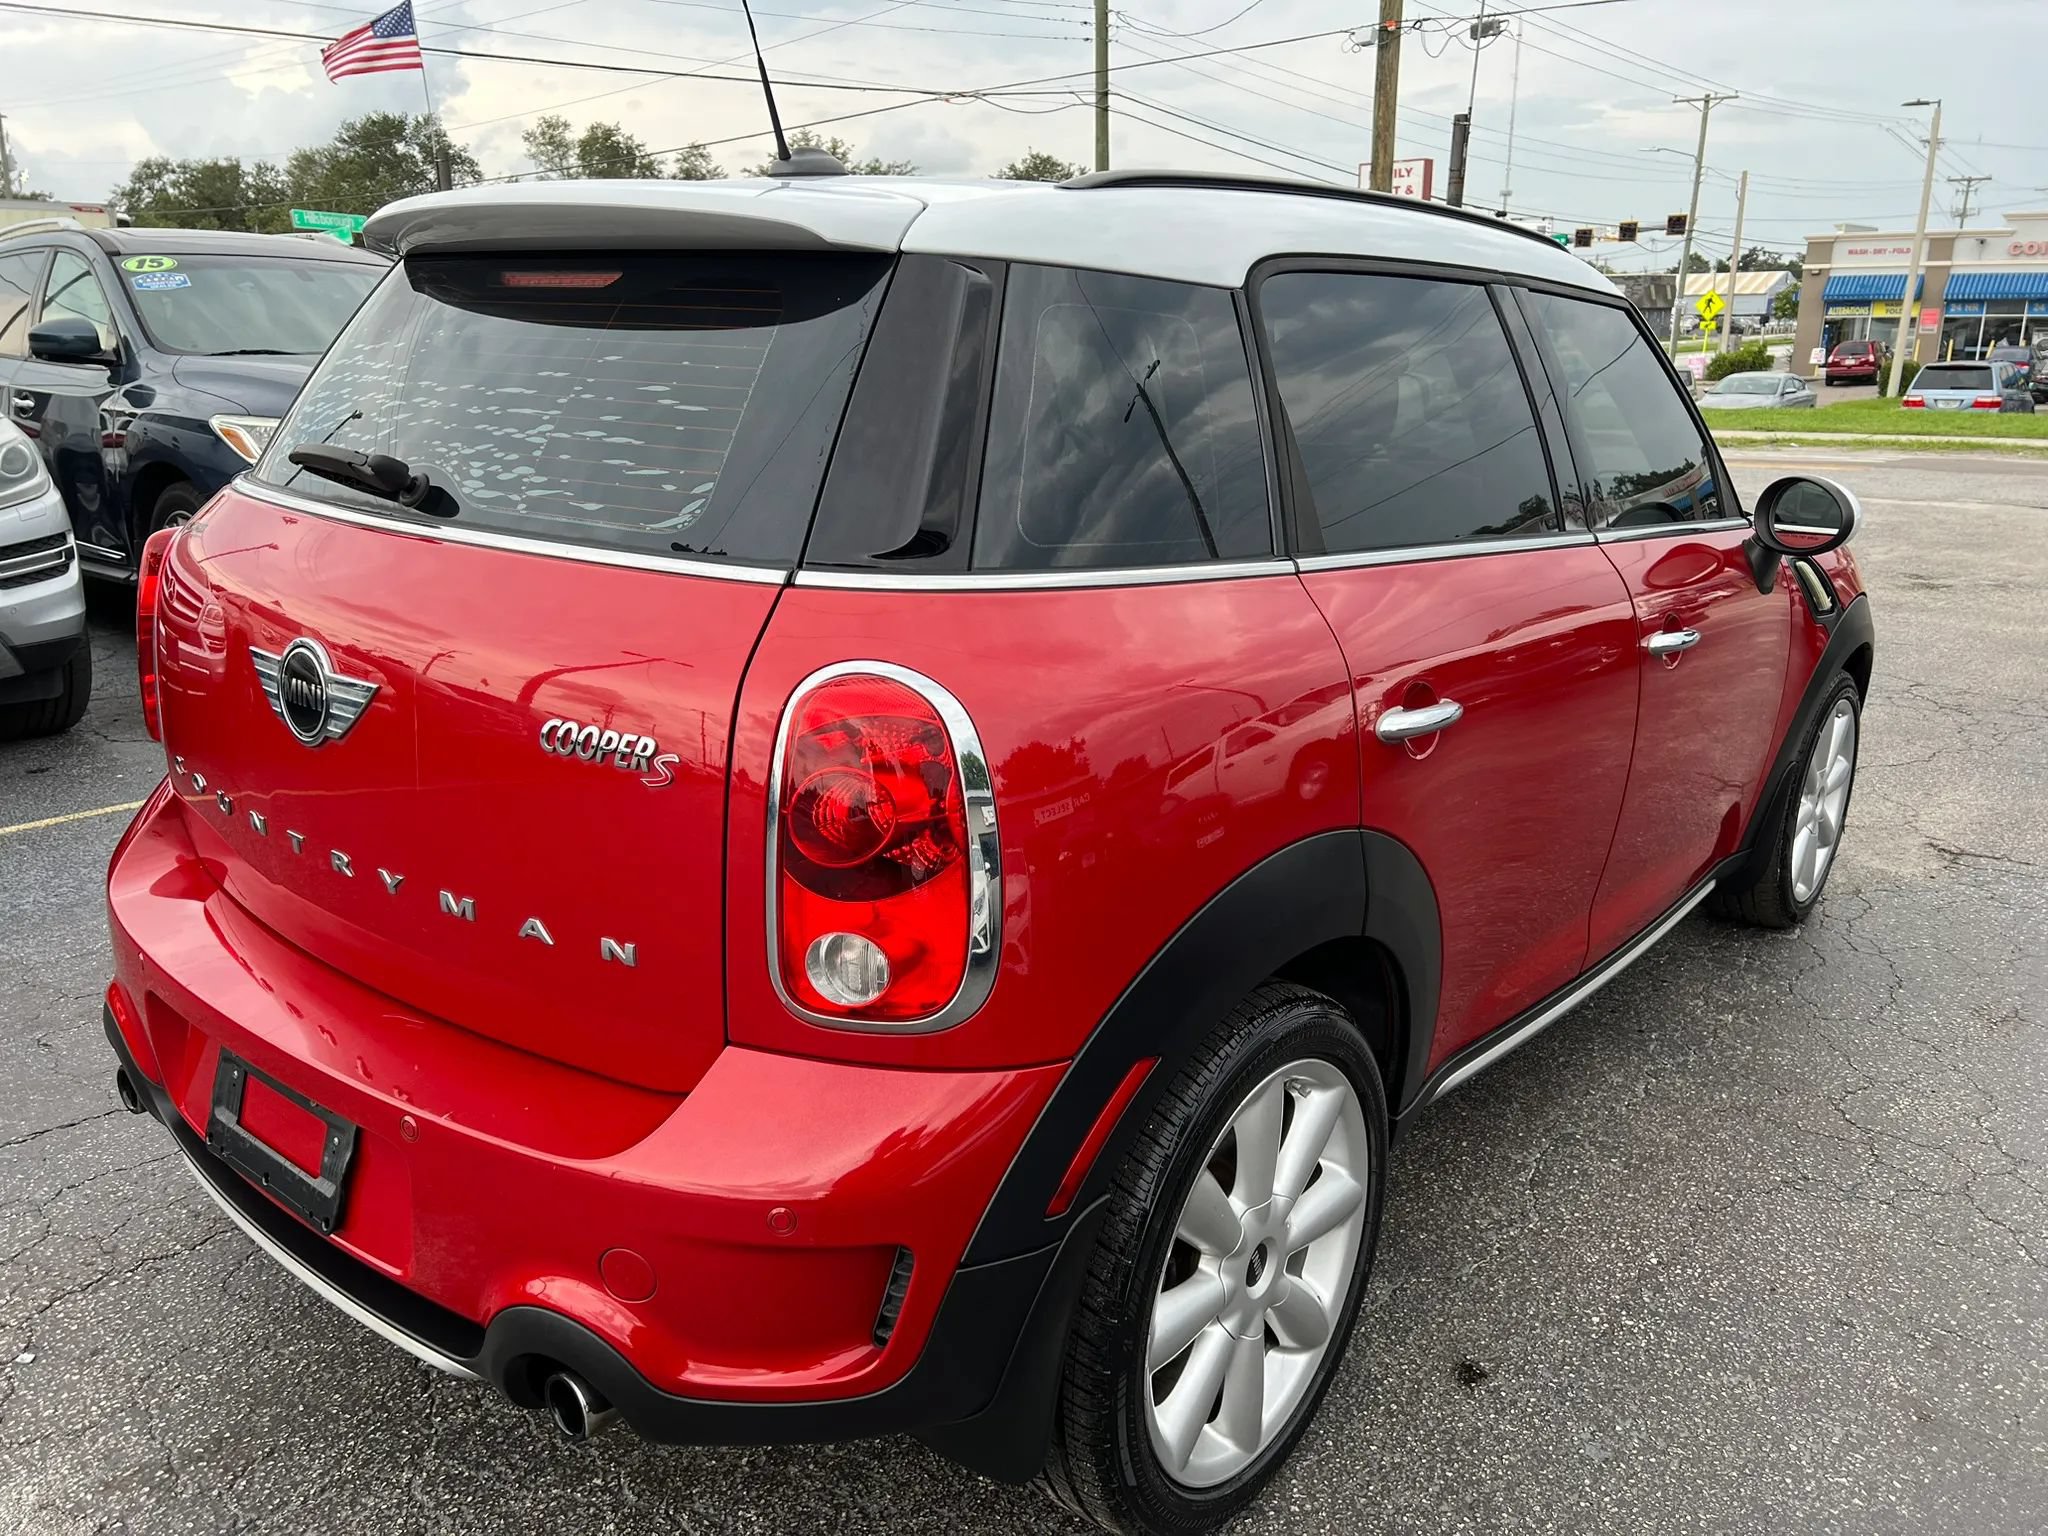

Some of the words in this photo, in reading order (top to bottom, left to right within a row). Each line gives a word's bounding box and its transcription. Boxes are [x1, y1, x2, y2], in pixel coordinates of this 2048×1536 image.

[135, 257, 164, 270] 15
[539, 718, 656, 773] COOPER
[640, 753, 681, 787] S
[174, 755, 637, 968] COUNTRYMAN
